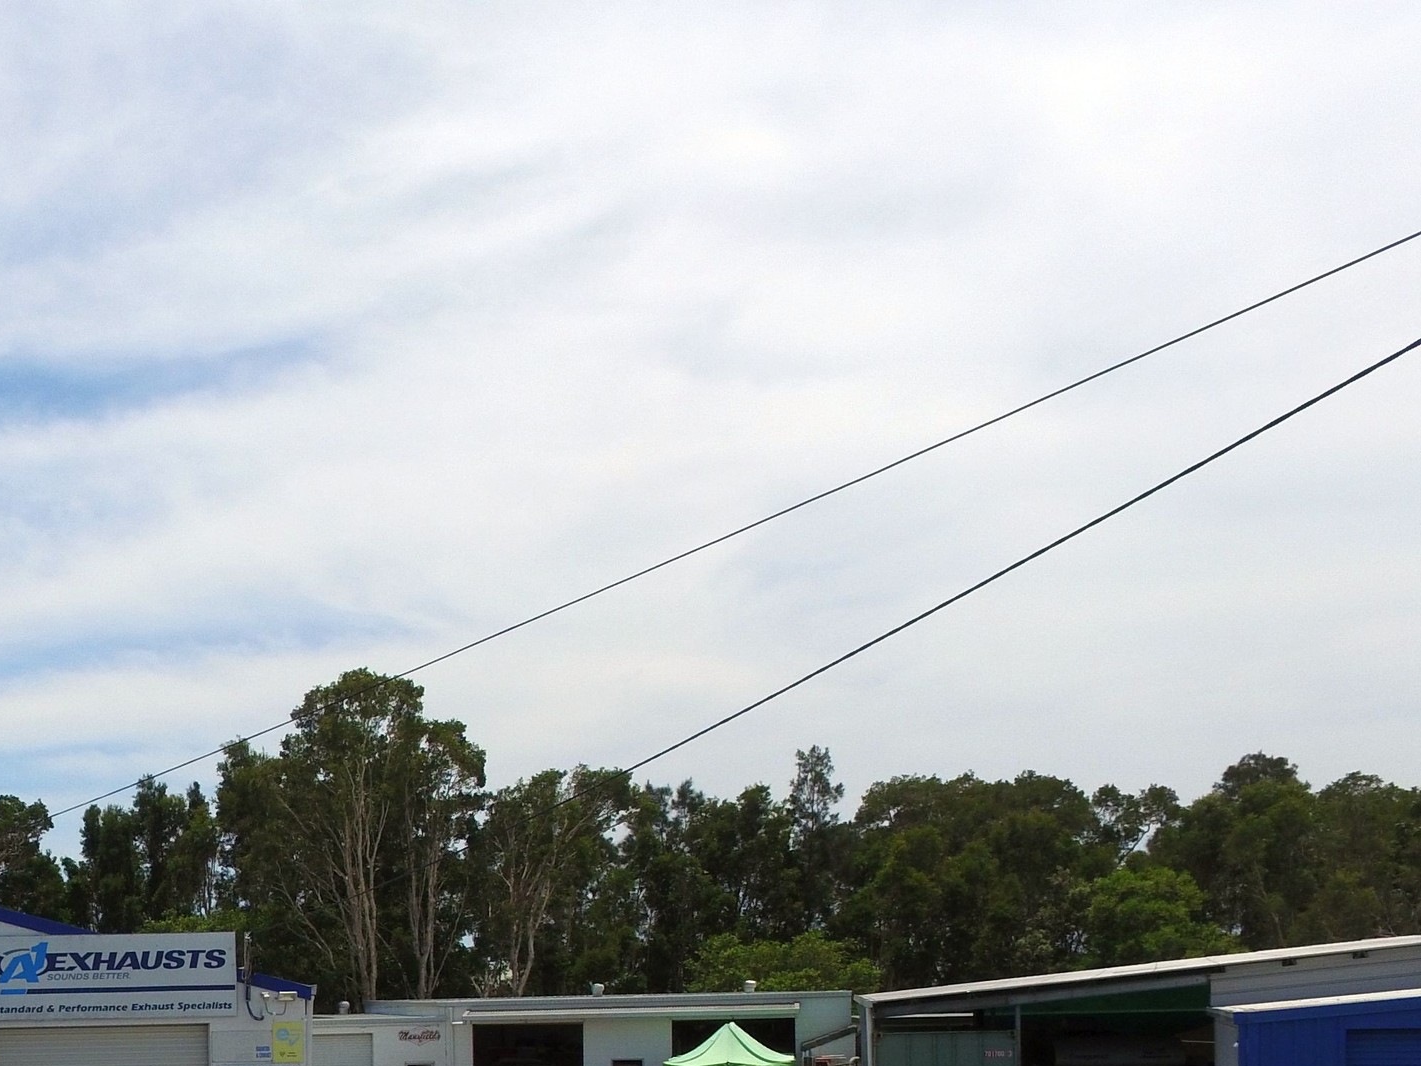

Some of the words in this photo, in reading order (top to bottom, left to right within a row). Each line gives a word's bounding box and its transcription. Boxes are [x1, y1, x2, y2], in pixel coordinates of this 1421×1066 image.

[47, 949, 226, 971] EXHAUSTS
[47, 973, 89, 981] SOUNDS
[46, 1004, 55, 1013] &
[58, 1004, 128, 1013] Performance
[131, 1002, 174, 1012] Exhaust
[177, 1001, 233, 1012] Specialists
